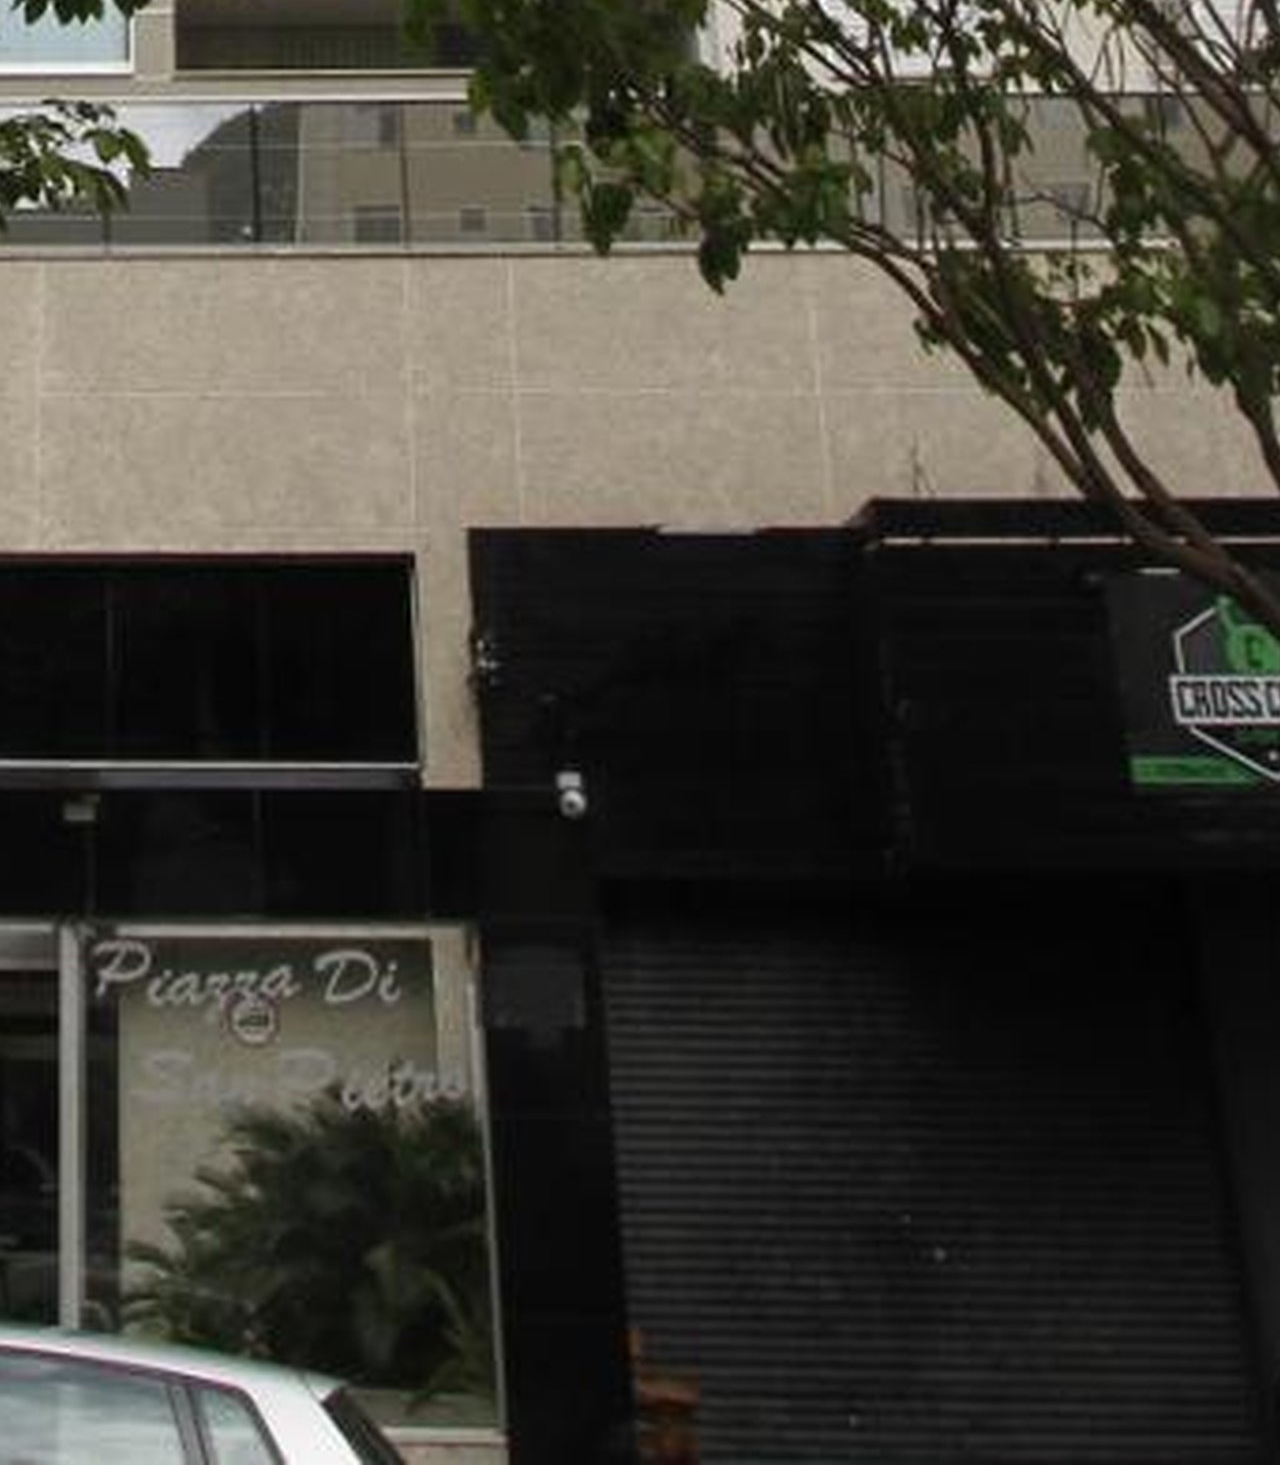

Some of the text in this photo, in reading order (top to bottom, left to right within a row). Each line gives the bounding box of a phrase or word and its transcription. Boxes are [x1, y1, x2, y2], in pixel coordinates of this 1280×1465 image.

[1177, 681, 1261, 719] CROSS
[91, 940, 402, 1013] Piazza Di
